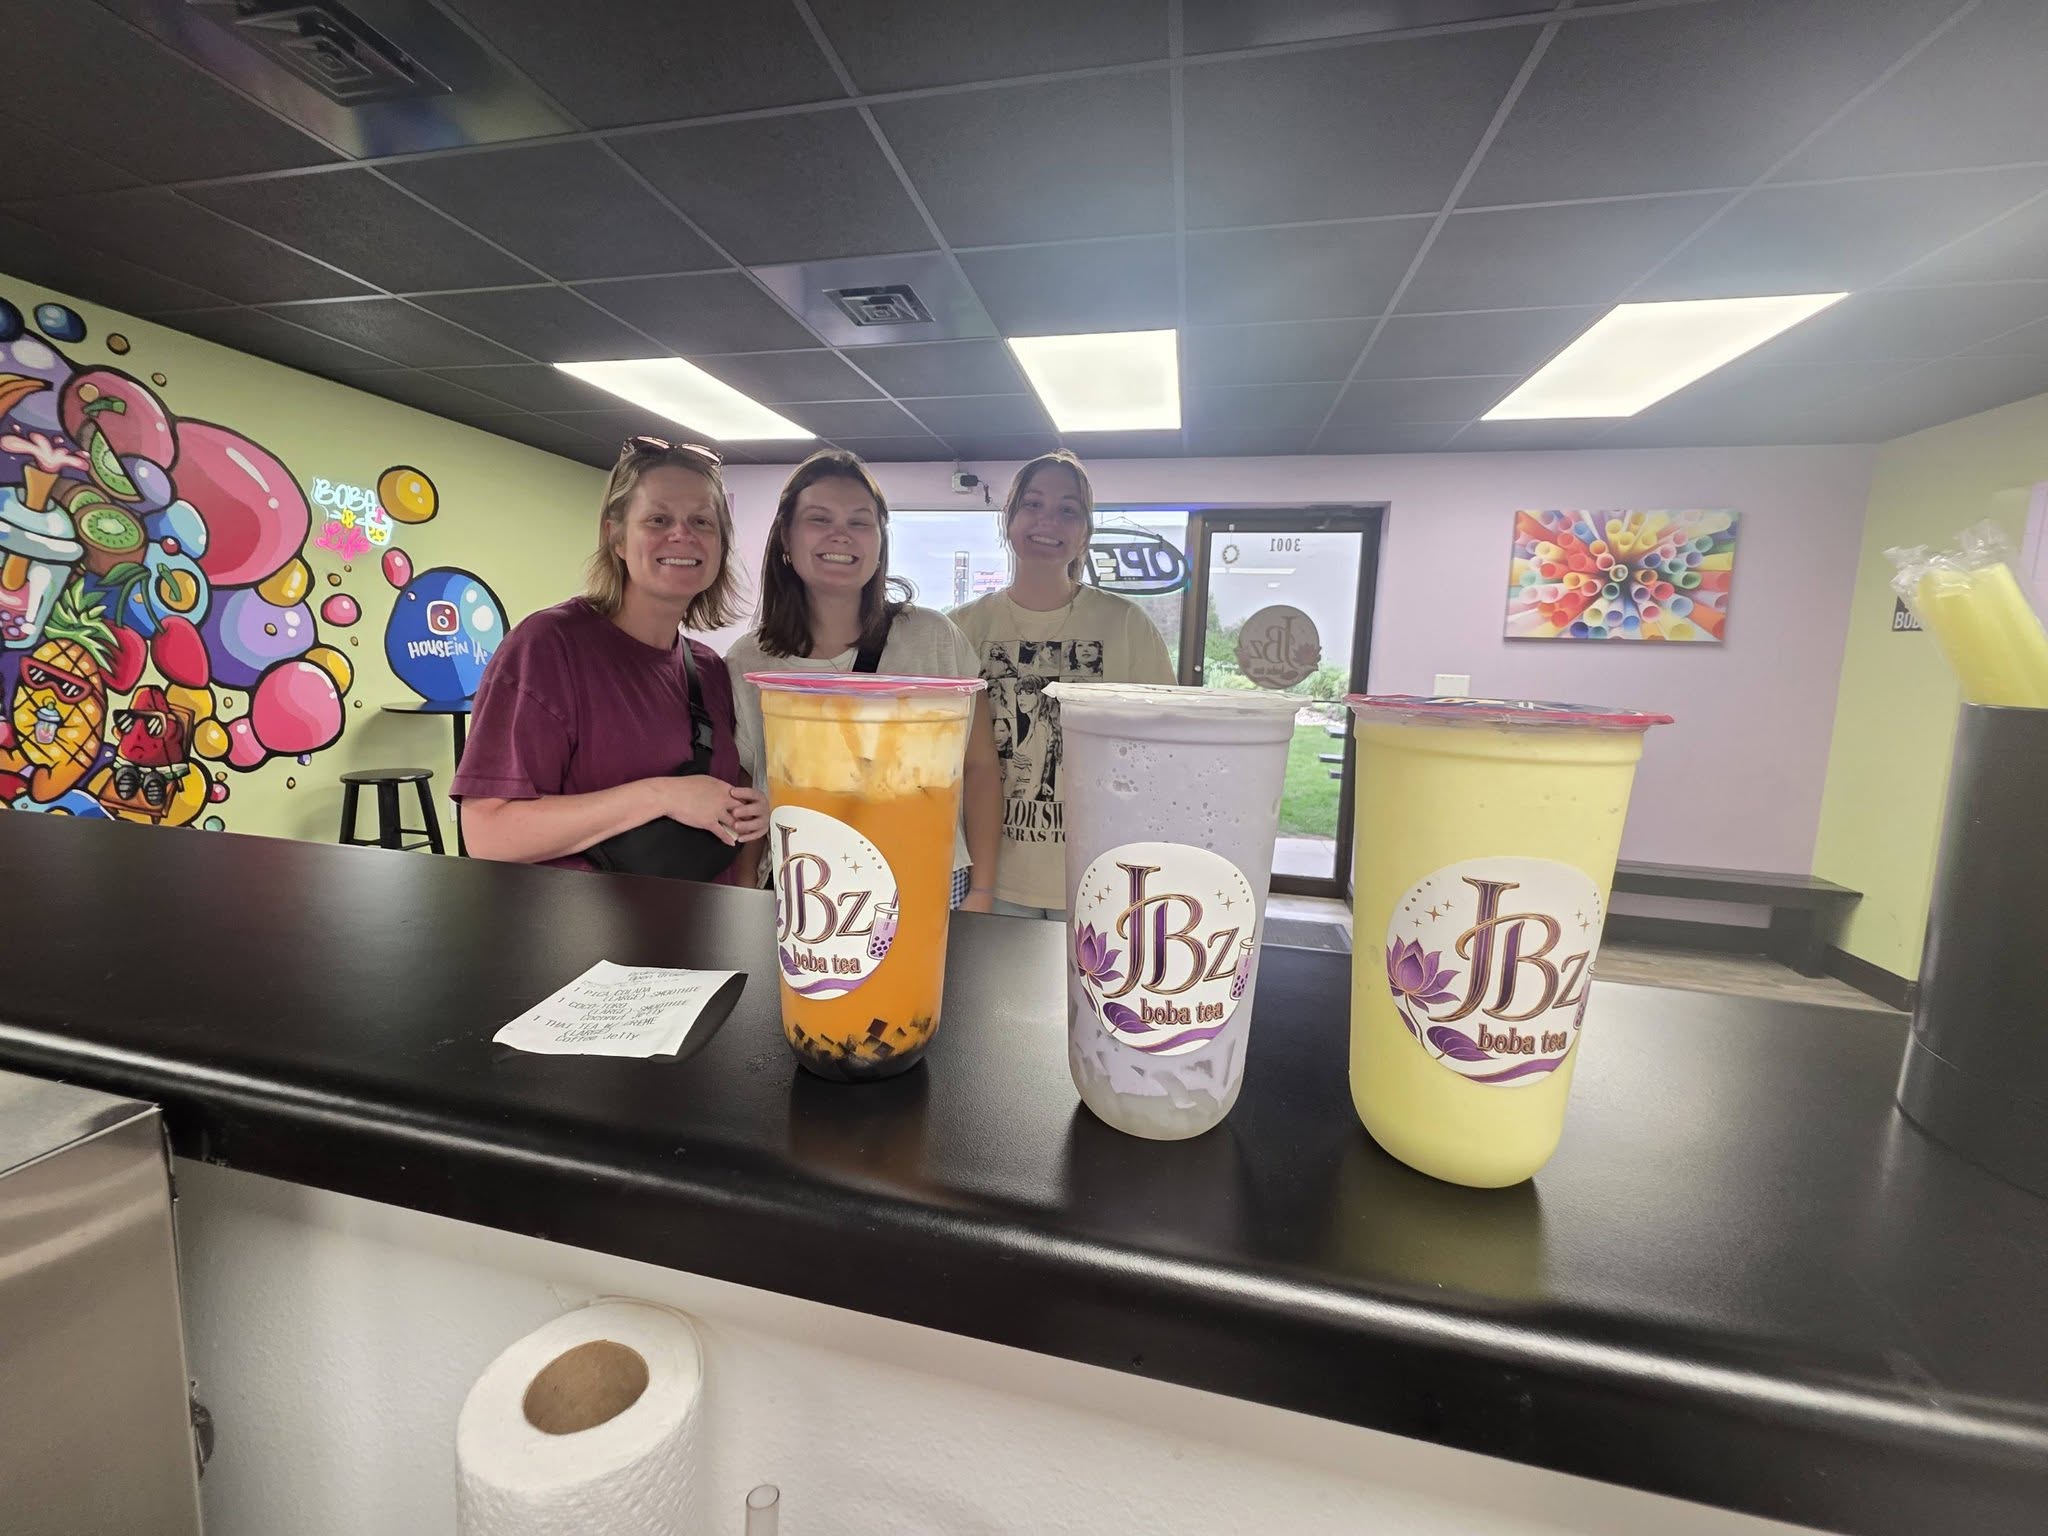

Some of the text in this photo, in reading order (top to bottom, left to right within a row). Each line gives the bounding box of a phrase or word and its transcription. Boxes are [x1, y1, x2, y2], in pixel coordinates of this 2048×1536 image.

[313, 478, 377, 515] BOBA
[1102, 861, 1240, 999] JBz
[791, 944, 862, 975] boba tea
[1427, 876, 1591, 1022] JBz
[1139, 997, 1225, 1025] boba tea
[1476, 1023, 1568, 1055] boba tea
